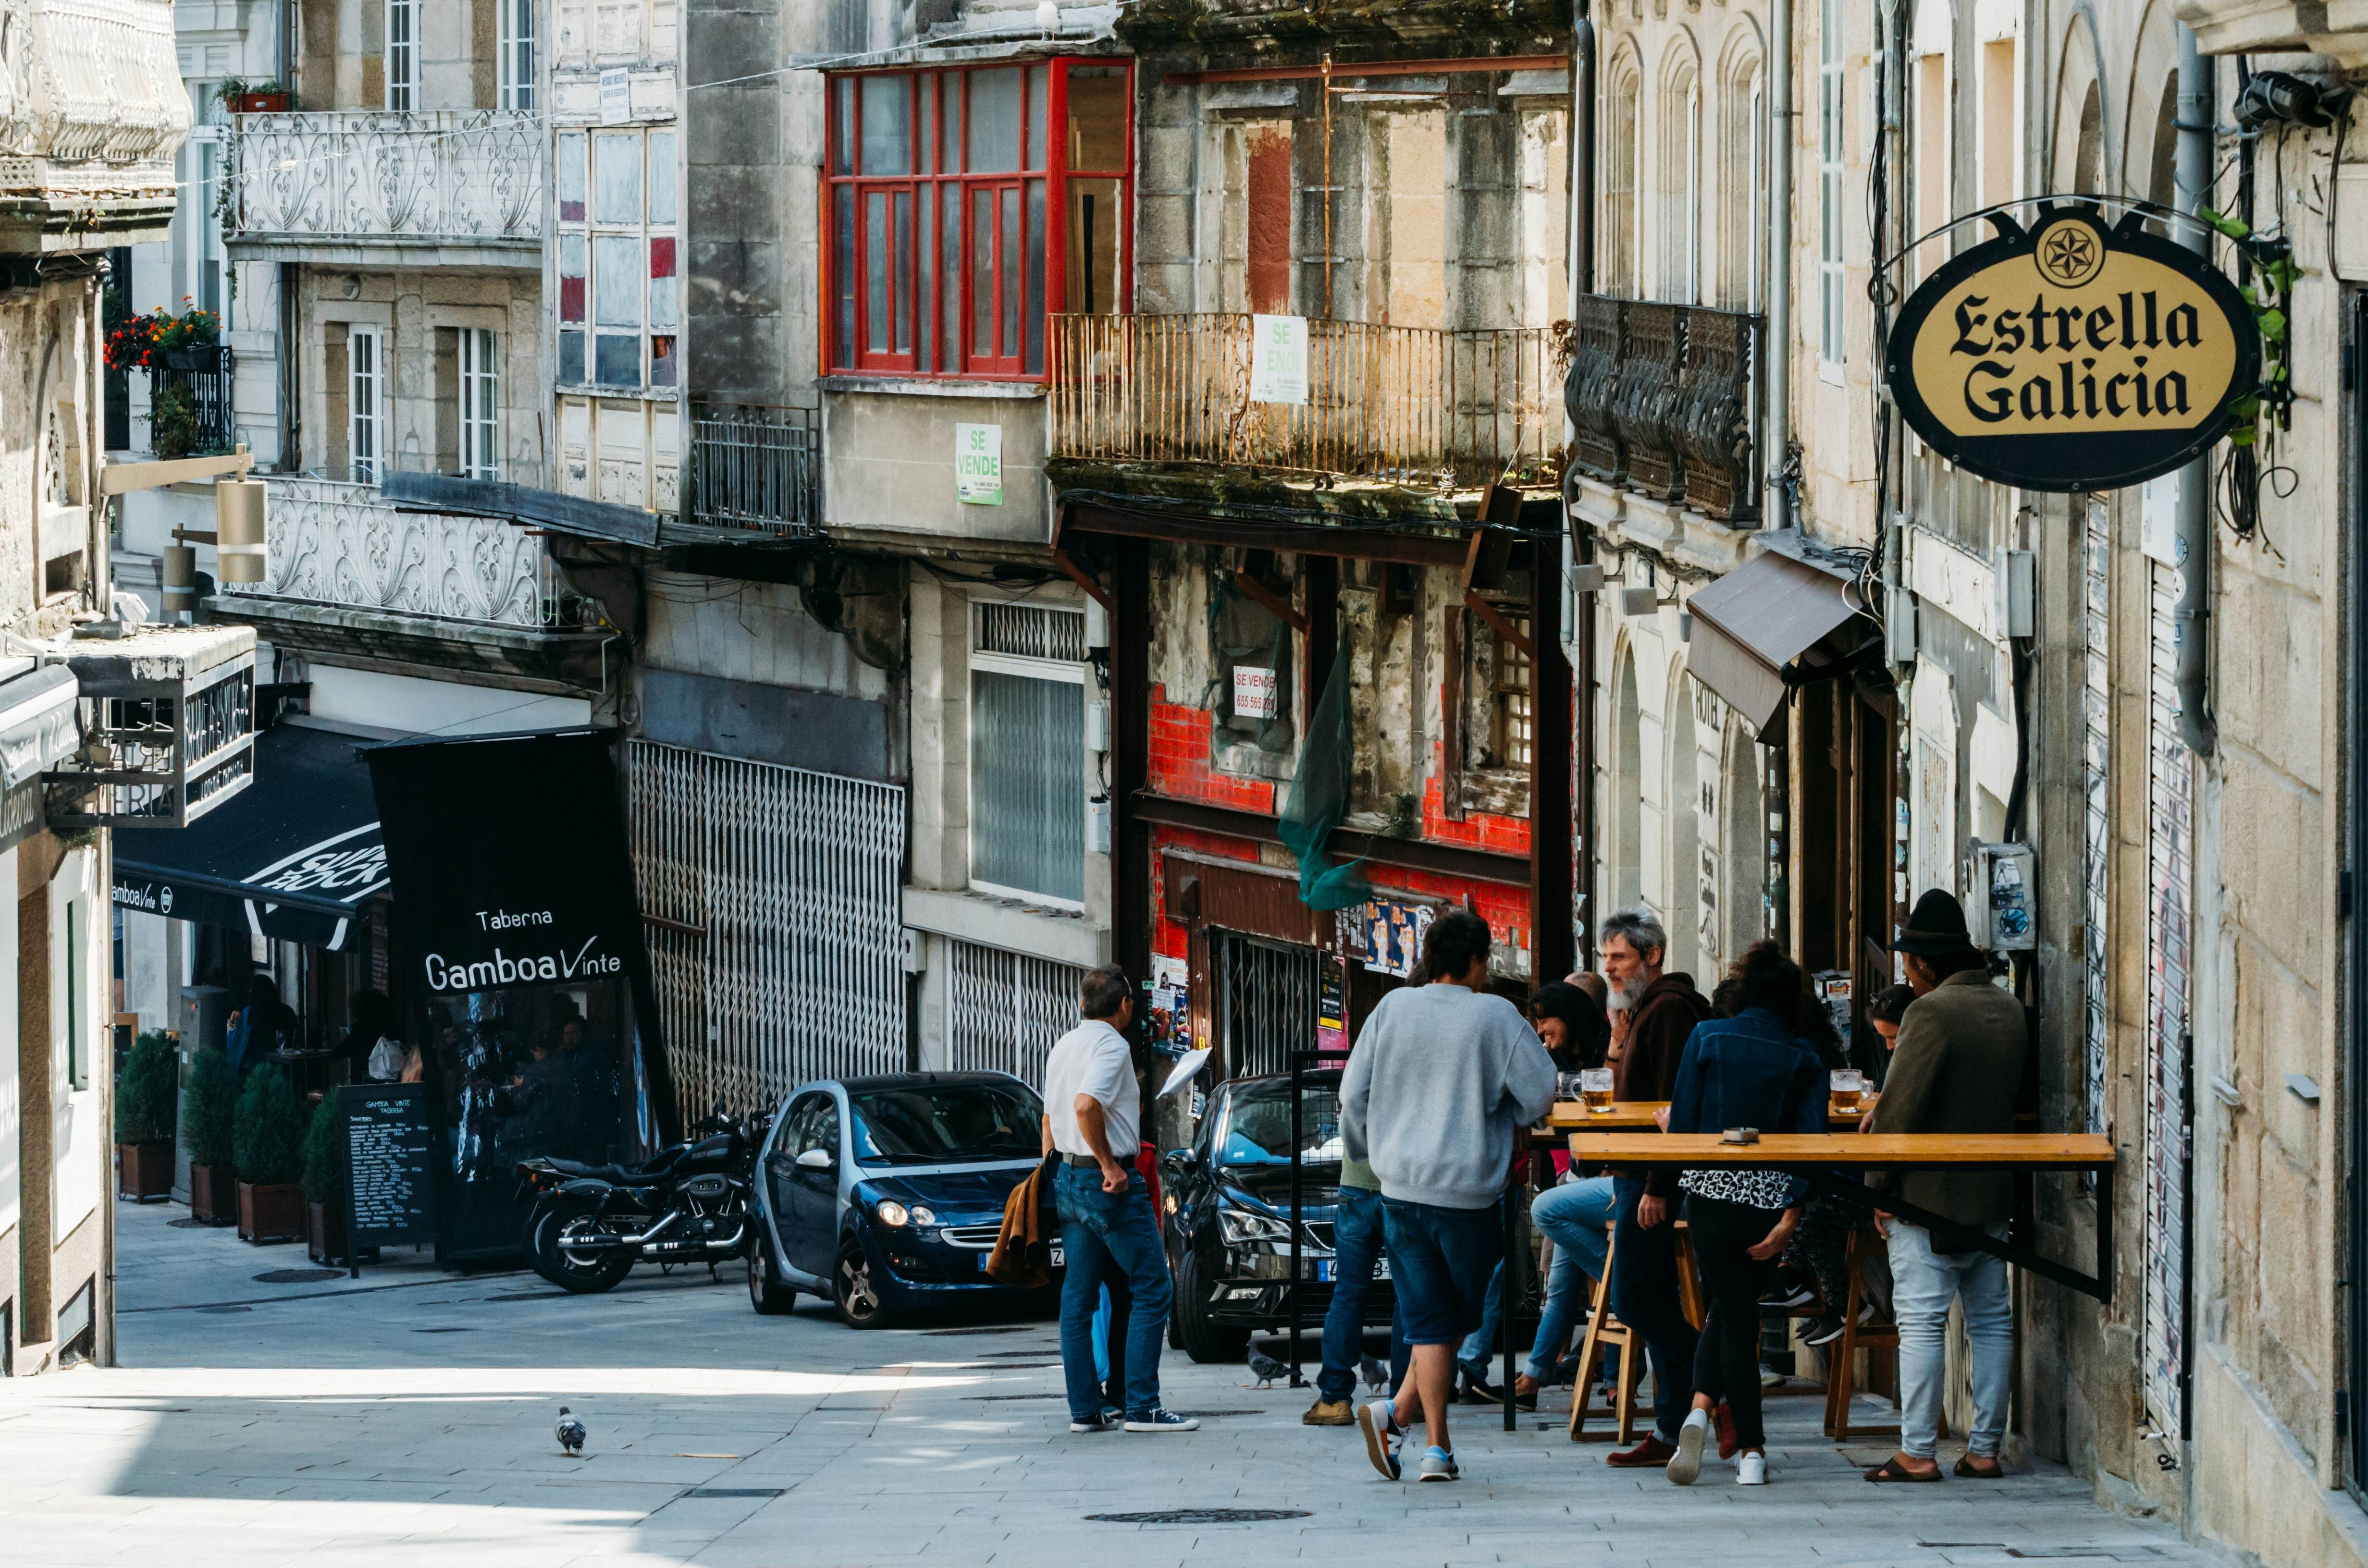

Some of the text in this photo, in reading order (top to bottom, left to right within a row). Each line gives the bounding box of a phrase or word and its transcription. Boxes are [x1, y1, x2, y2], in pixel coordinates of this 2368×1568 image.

[1273, 323, 1290, 344] SE
[1950, 290, 2203, 356] Estrella
[1964, 356, 2192, 423] Galicia
[971, 429, 985, 451] SE
[958, 454, 999, 476] VENDE
[1237, 674, 1275, 688] SE VENDE
[1237, 695, 1248, 708] 655
[1250, 697, 1261, 709] 565
[112, 880, 140, 906] amboa
[476, 909, 553, 931] Taberna
[426, 948, 557, 991] Gamboa
[560, 935, 621, 979] Vinte
